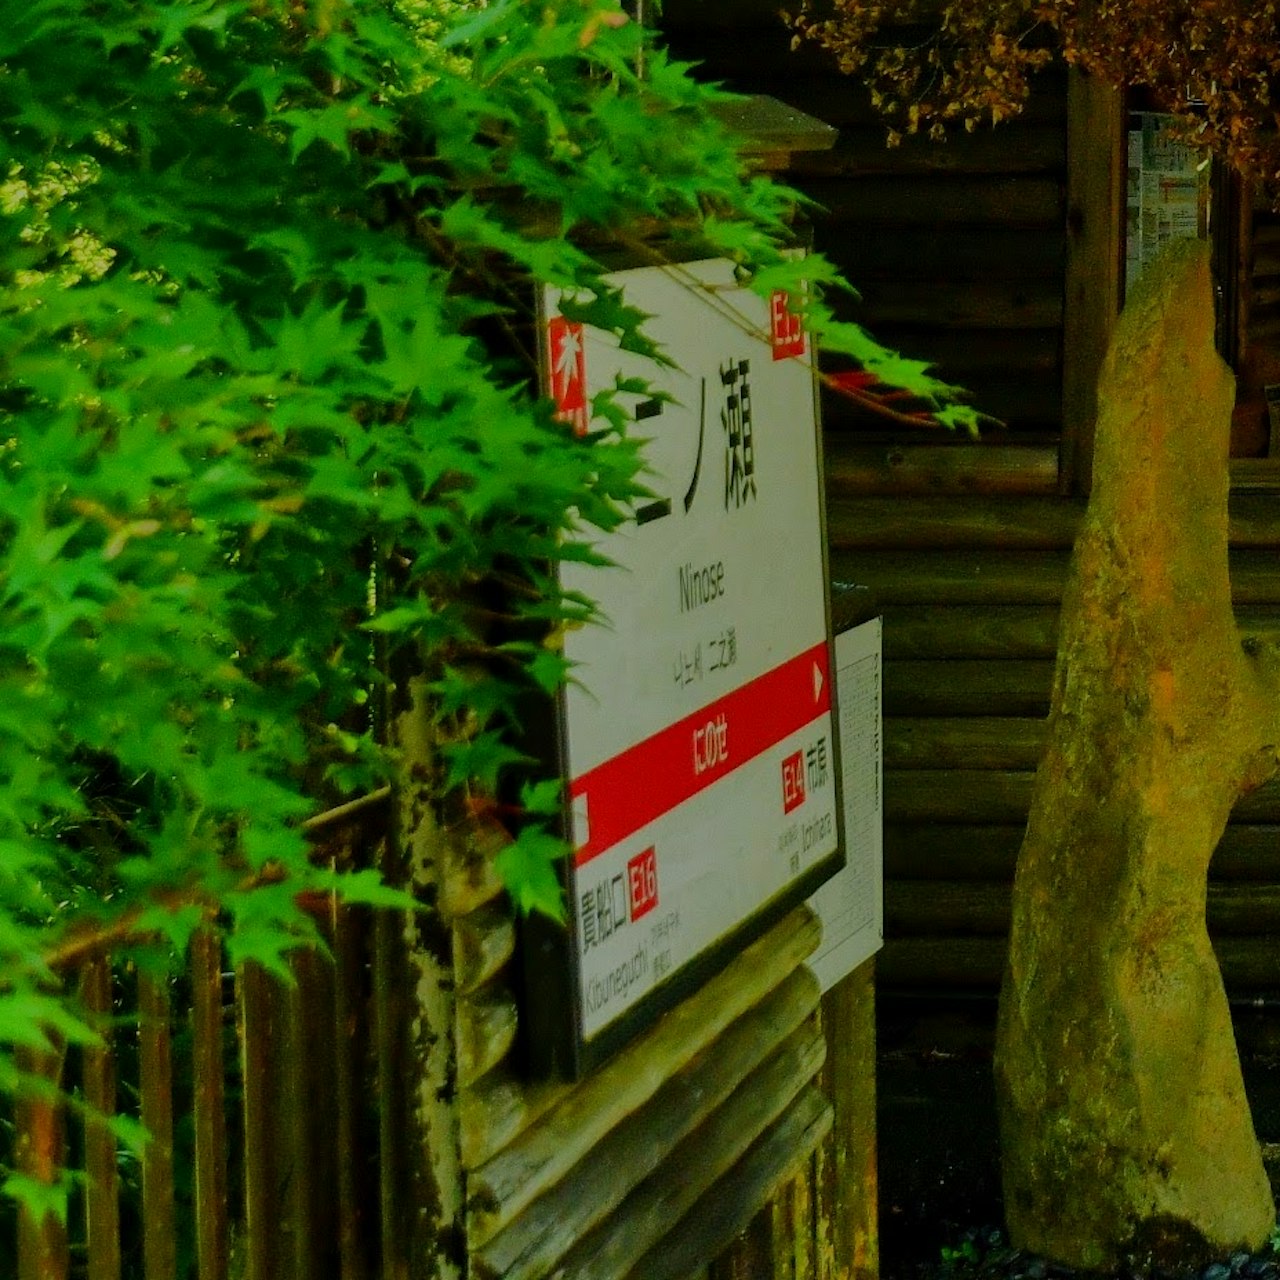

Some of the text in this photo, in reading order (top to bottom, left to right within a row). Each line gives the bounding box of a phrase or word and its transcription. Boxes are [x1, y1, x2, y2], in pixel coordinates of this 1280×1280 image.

[635, 351, 757, 527] 二ノ瀬
[680, 561, 725, 614] Ninose
[692, 712, 729, 776] にのせ
[783, 736, 828, 806] E14 市原
[581, 854, 657, 956] 貴船口 E16
[584, 946, 649, 1015] Kibuneguchi
